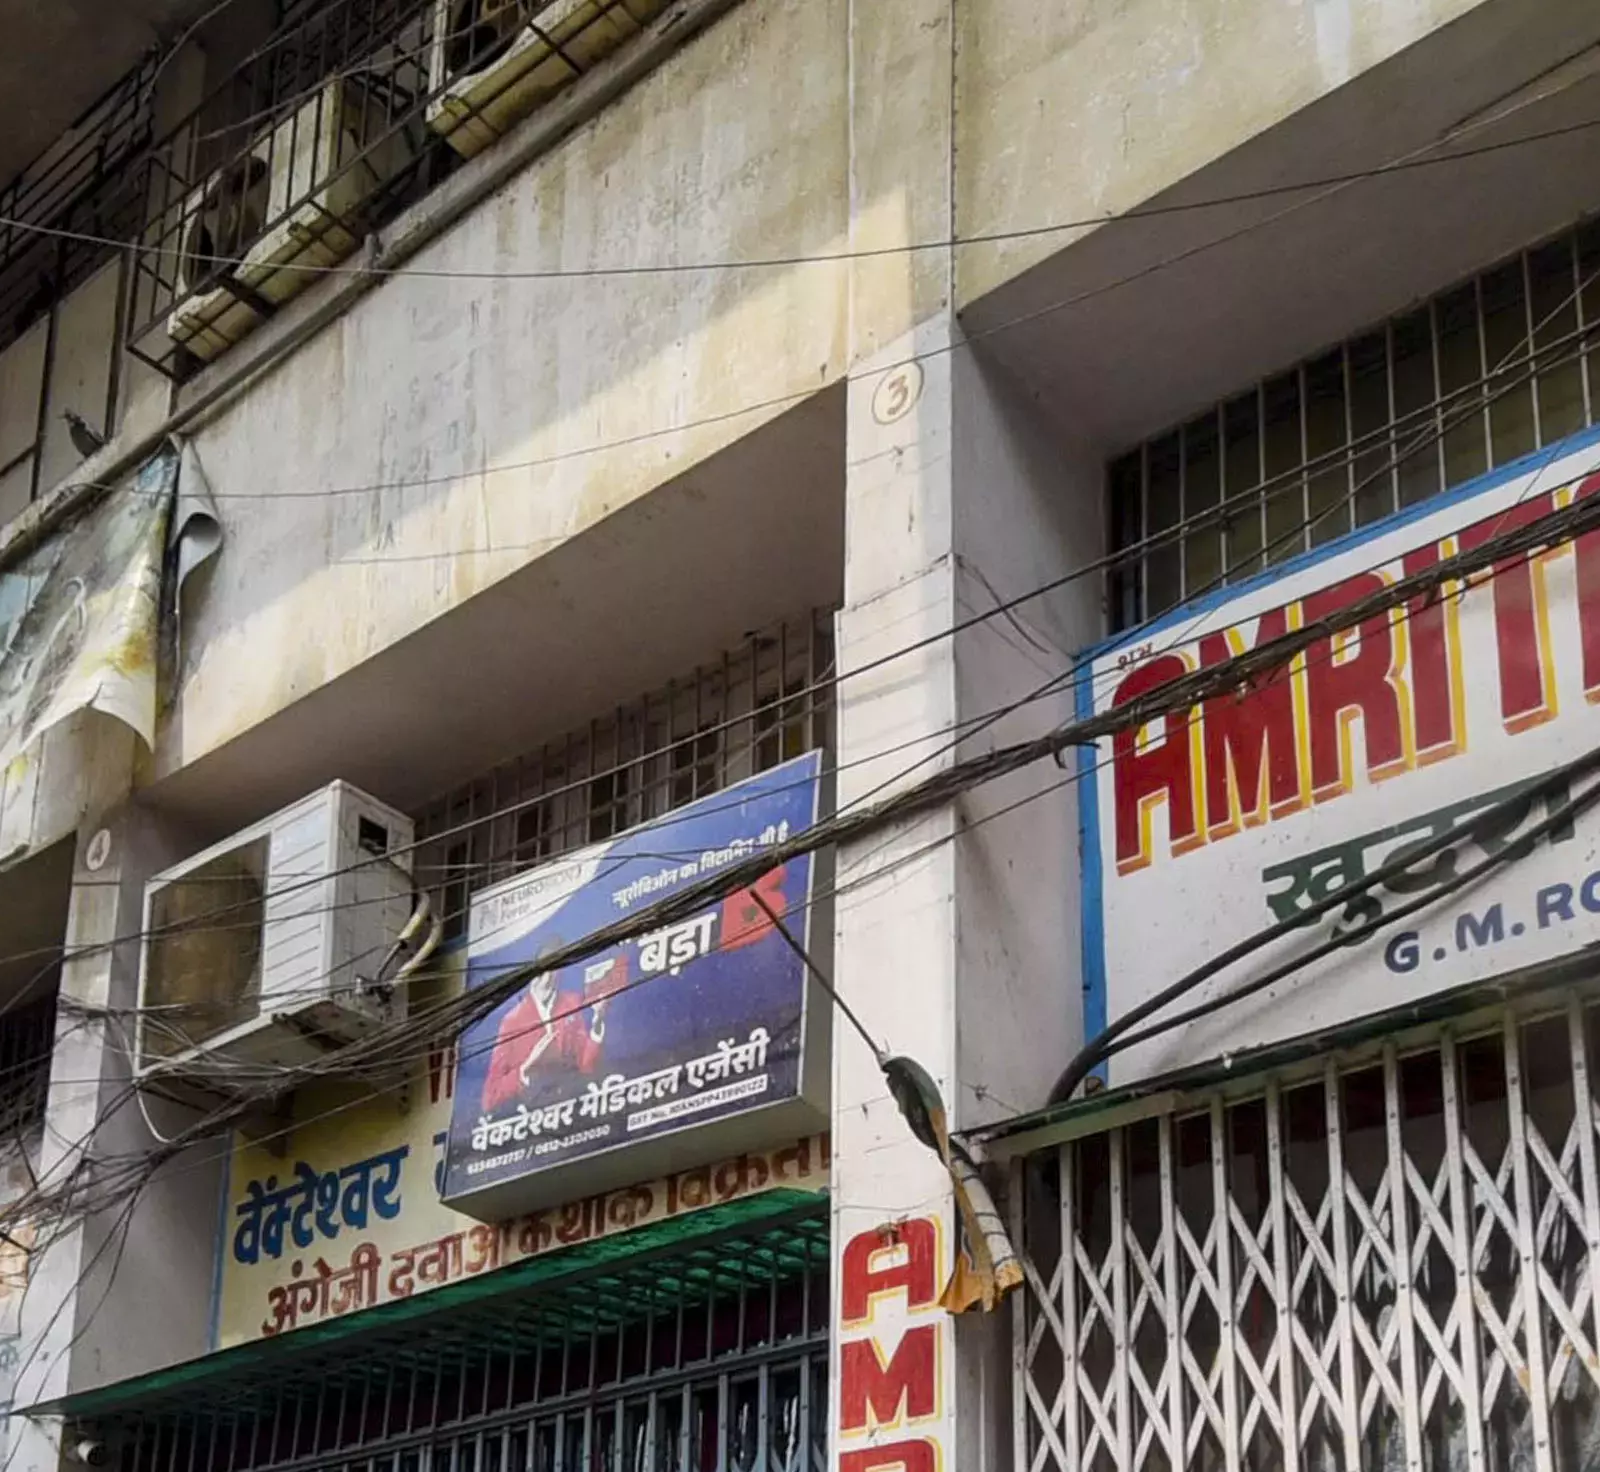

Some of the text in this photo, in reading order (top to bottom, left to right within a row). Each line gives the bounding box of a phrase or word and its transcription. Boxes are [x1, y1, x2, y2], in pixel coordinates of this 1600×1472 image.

[638, 911, 718, 976] बड़ा
[471, 1099, 577, 1152] वेंकटेश्वर
[579, 1065, 683, 1119] मेडिकल
[686, 1027, 771, 1089] एजेंसी
